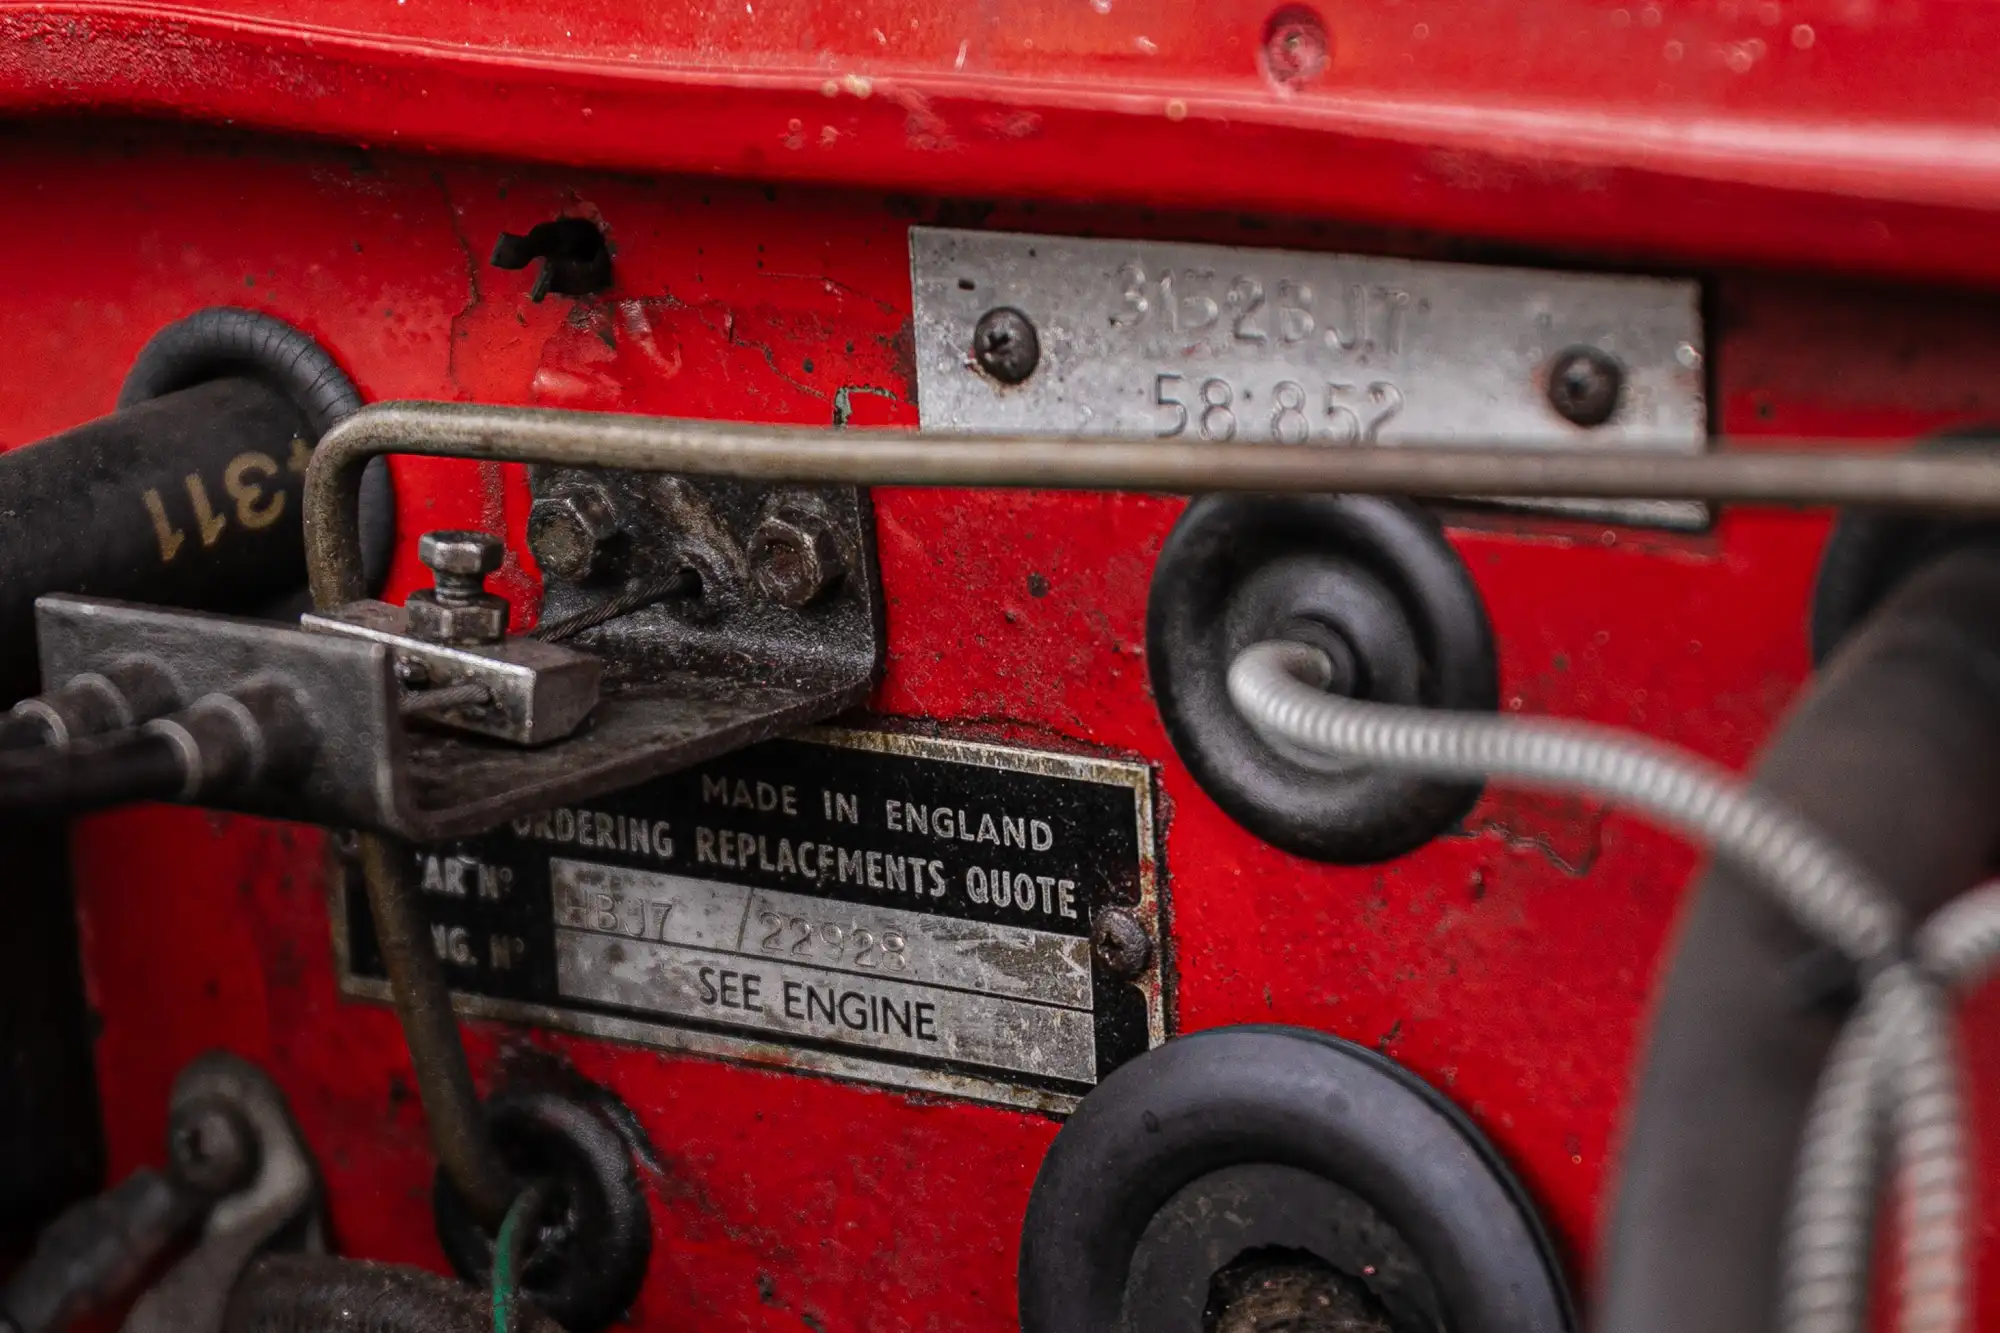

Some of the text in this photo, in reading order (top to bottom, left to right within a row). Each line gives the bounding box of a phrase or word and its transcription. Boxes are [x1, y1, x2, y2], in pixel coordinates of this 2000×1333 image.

[703, 774, 1053, 852] MADE IN ENGLAND
[416, 851, 466, 895] AR
[695, 827, 946, 898] REPLACEMENTS
[966, 866, 1077, 920] QUOTE
[699, 966, 762, 1014] SEE
[783, 984, 938, 1042] ENGINE
